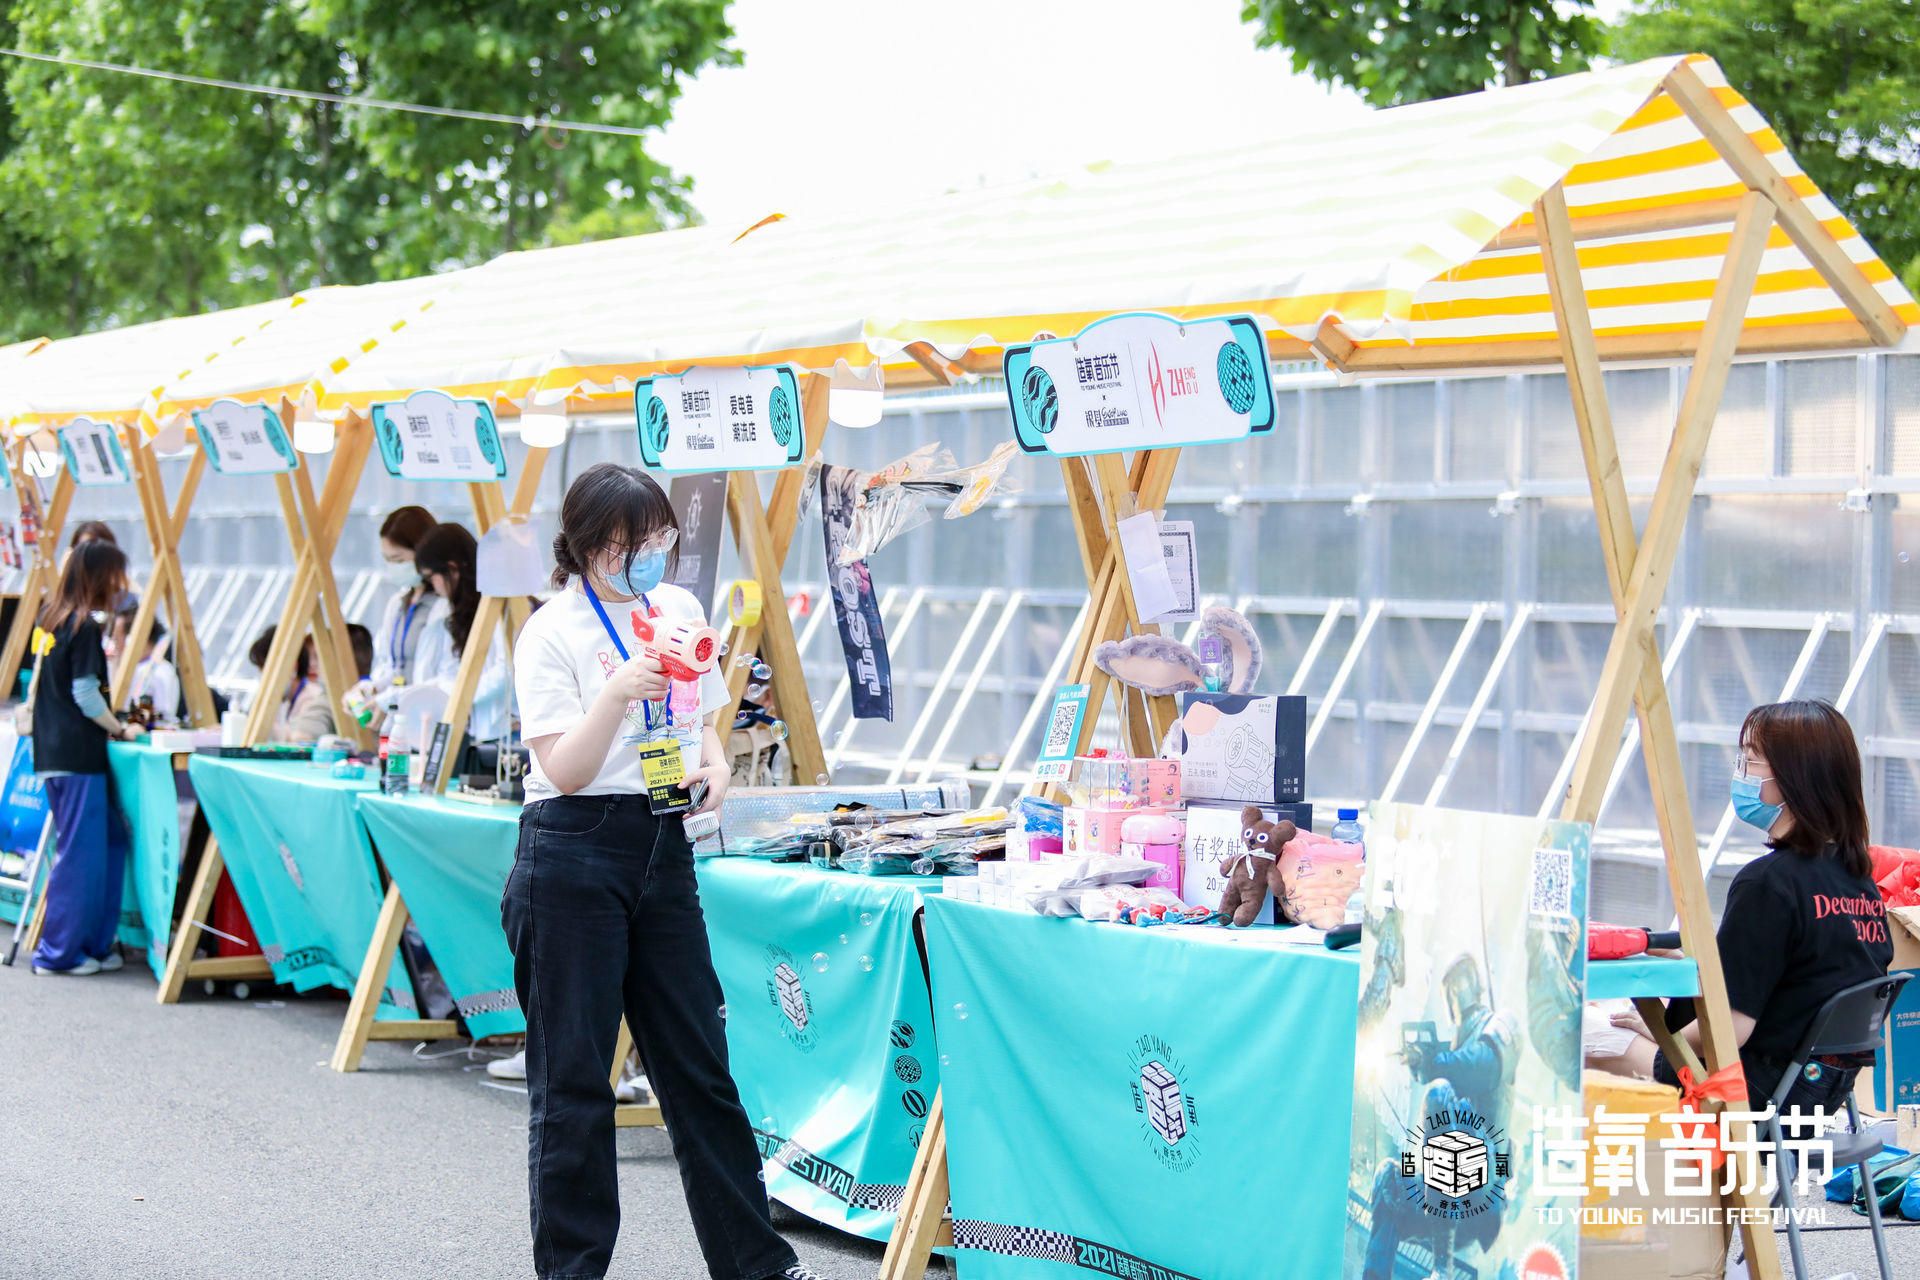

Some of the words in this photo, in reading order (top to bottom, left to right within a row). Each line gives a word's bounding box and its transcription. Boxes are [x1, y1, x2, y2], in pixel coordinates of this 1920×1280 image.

[1075, 353, 1120, 383] 造氧音乐节
[681, 390, 711, 413] 造氧音乐节
[730, 393, 754, 416] 爱电音
[732, 421, 757, 442] 潮流店
[1077, 1241, 1117, 1273] 2021
